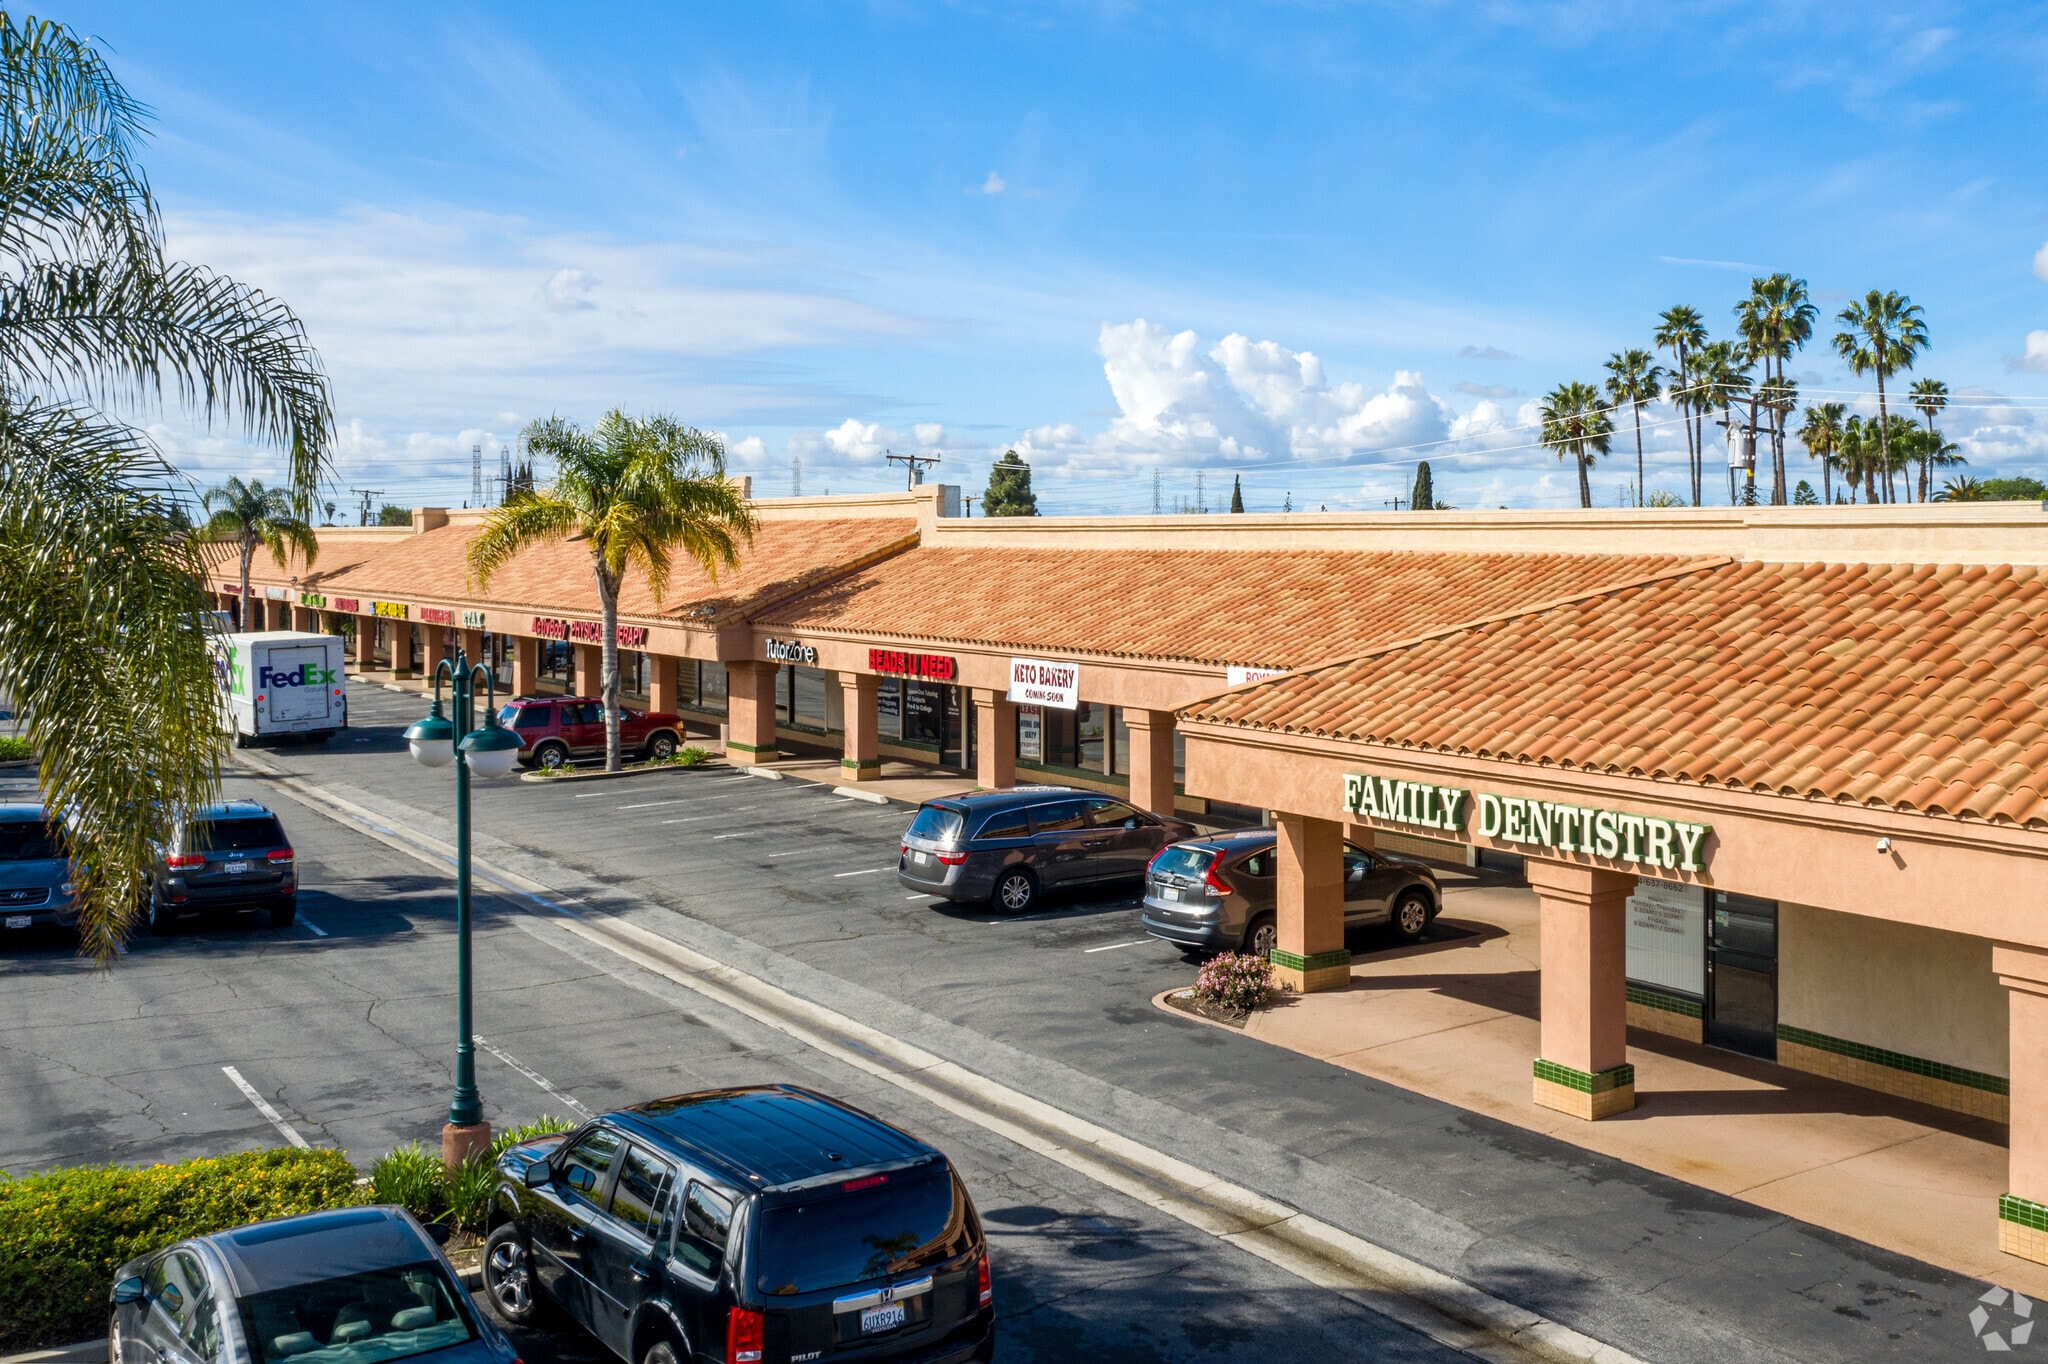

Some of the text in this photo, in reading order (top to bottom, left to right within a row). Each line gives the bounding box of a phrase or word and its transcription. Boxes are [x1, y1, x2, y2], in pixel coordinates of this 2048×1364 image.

[571, 620, 603, 641] PHYSICAL
[616, 625, 644, 646] ERAPY
[765, 639, 815, 662] TutorZone
[259, 663, 336, 689] FedEx
[869, 648, 953, 680] BEADS U NEED
[1014, 664, 1074, 689] KETO BAKERY
[1025, 688, 1064, 702] COMING SOON
[1342, 773, 1712, 873] FAMILY DENTISTRY
[1638, 878, 1683, 892] 4-637-8662
[864, 1308, 903, 1330] 6UXR916
[791, 1351, 821, 1363] PILOT
